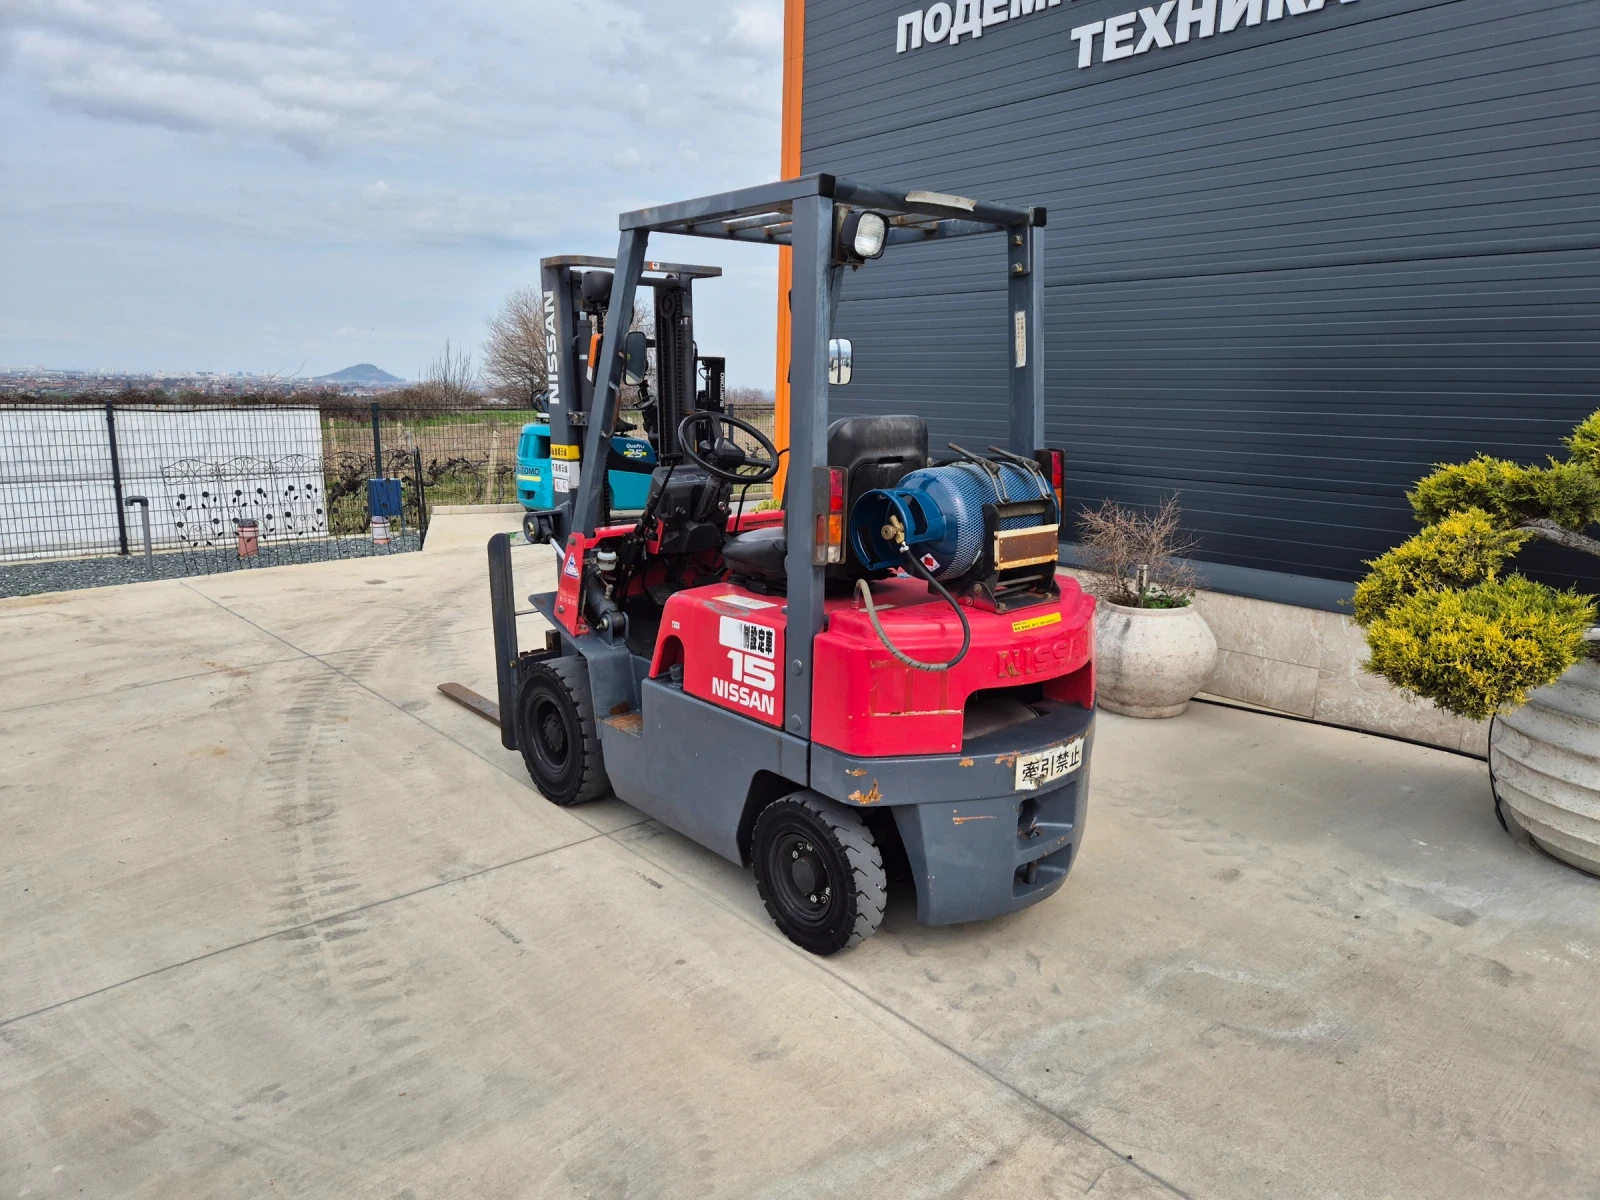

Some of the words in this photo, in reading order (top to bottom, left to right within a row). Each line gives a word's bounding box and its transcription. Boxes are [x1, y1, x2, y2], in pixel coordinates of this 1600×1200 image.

[896, 0, 1077, 53] ПОДЕ
[1070, 0, 1357, 68] ТЕХНИ
[543, 290, 560, 405] NISSAN
[626, 449, 643, 458] 25
[727, 650, 775, 691] 15
[712, 677, 775, 716] NISSAN
